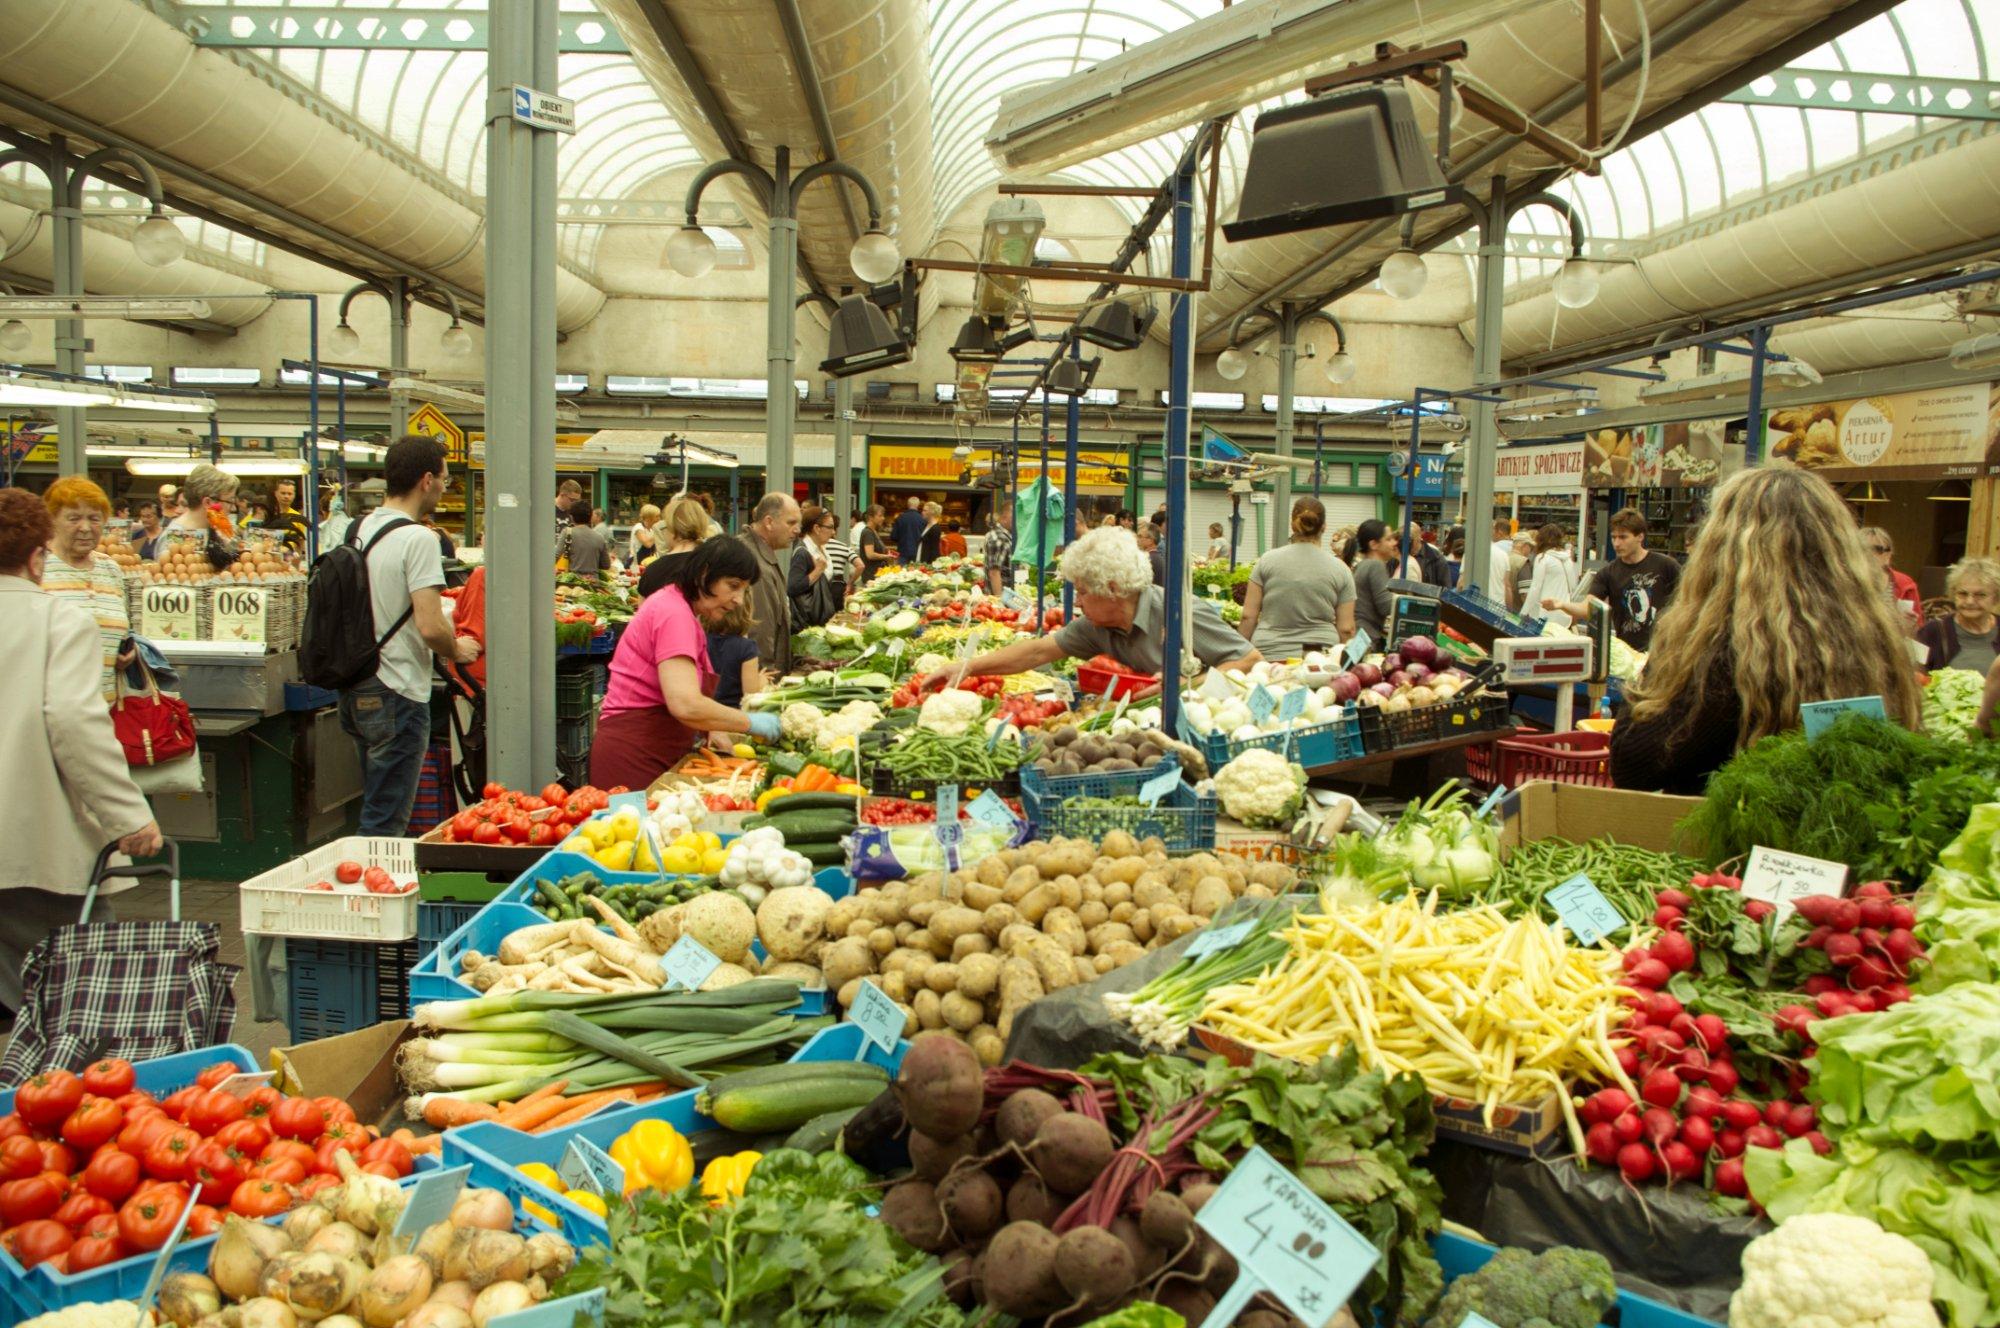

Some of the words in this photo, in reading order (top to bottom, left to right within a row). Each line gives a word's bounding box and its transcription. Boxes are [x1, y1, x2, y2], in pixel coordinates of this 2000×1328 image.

[1848, 416, 1883, 427] PIEKARNIA
[1844, 429, 1886, 446] Artur
[1243, 1201, 1275, 1257] 4
